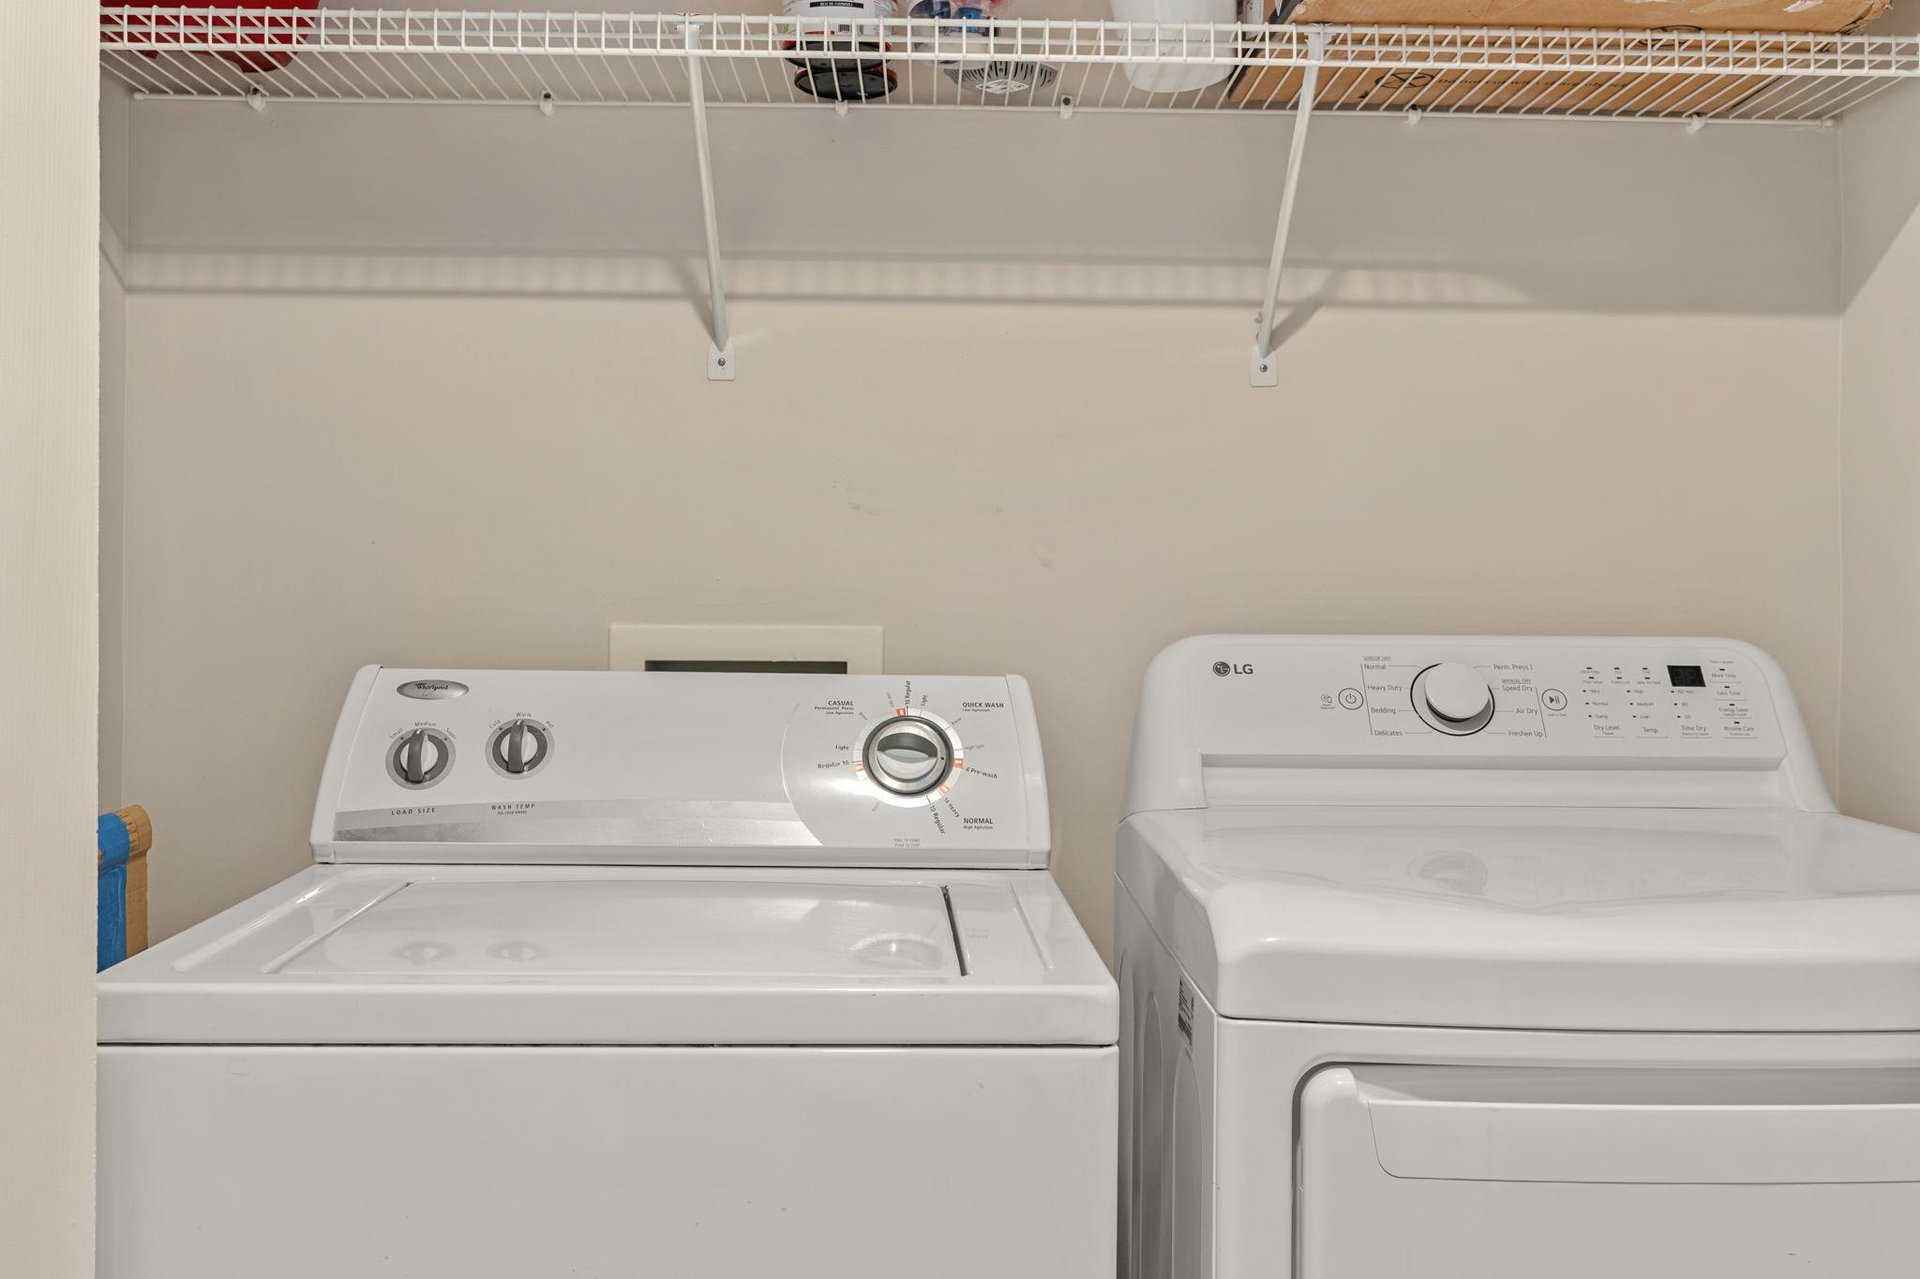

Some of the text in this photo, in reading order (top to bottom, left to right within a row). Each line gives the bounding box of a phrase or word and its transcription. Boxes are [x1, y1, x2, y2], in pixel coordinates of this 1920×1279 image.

[1233, 663, 1254, 674] LG
[415, 683, 448, 691] Whirlpool
[904, 680, 912, 699] Regular
[1534, 730, 1543, 738] Up
[970, 767, 998, 779] Pre-wash
[933, 811, 945, 834] Regular
